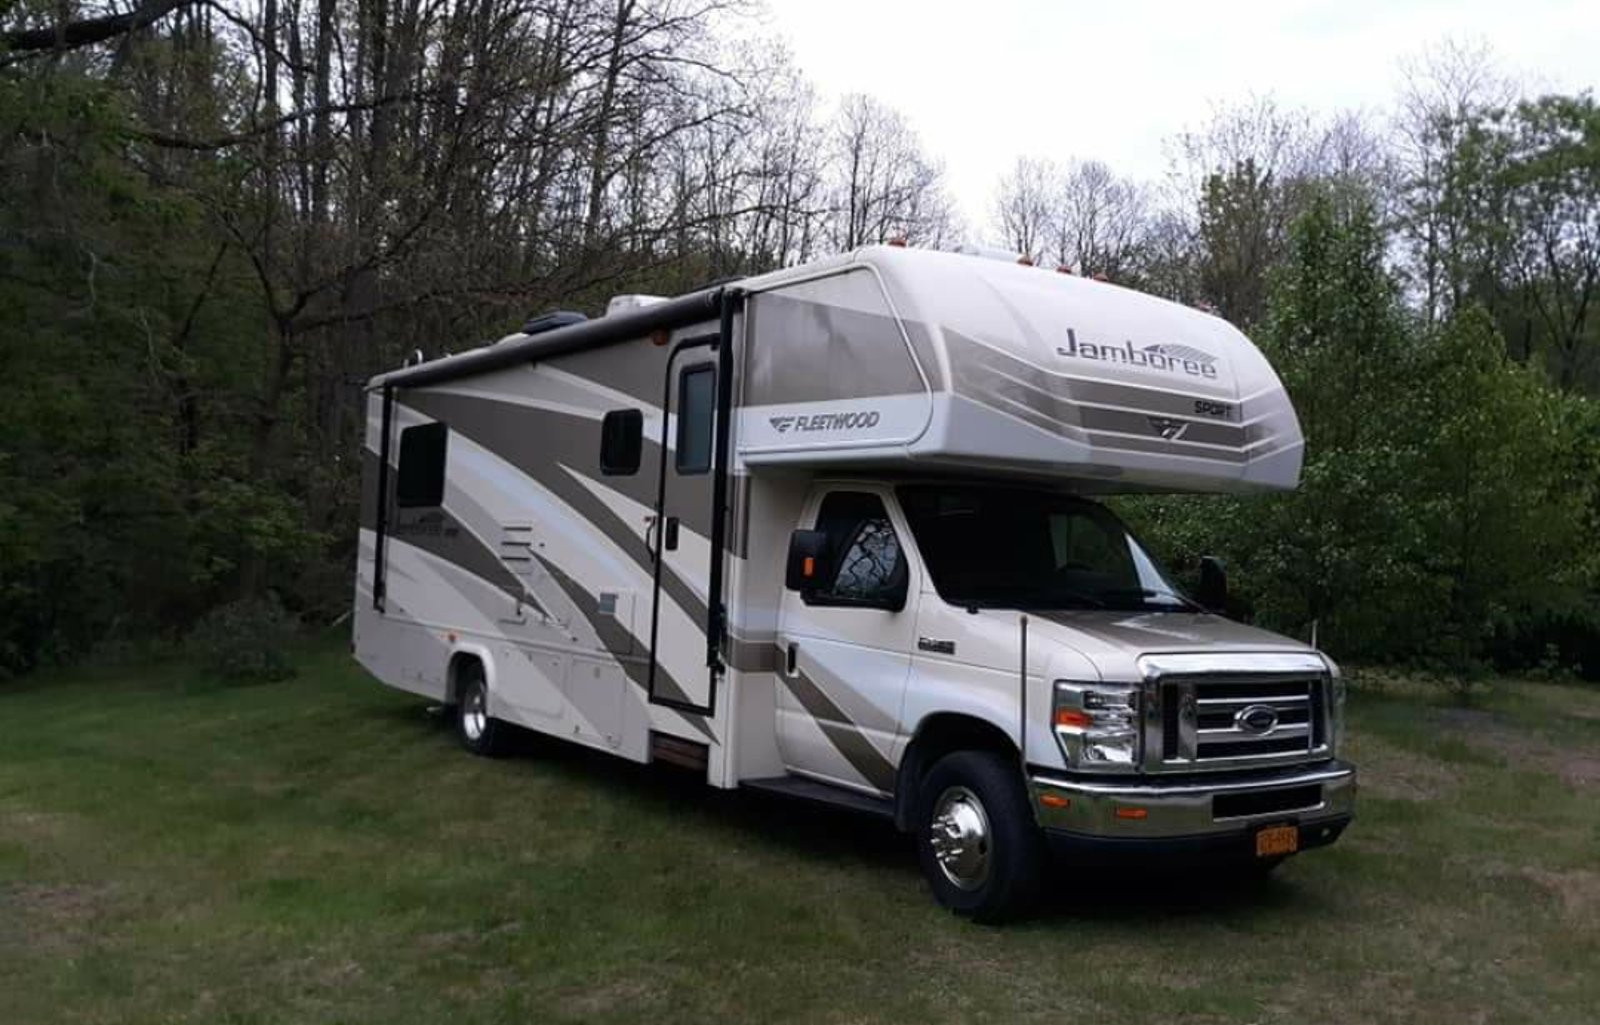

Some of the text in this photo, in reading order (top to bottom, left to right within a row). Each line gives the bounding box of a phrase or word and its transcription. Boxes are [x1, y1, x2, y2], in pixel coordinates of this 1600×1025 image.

[1057, 328, 1217, 379] Jamboree
[1194, 400, 1233, 417] SPORT
[795, 411, 880, 432] FLEETWOOD
